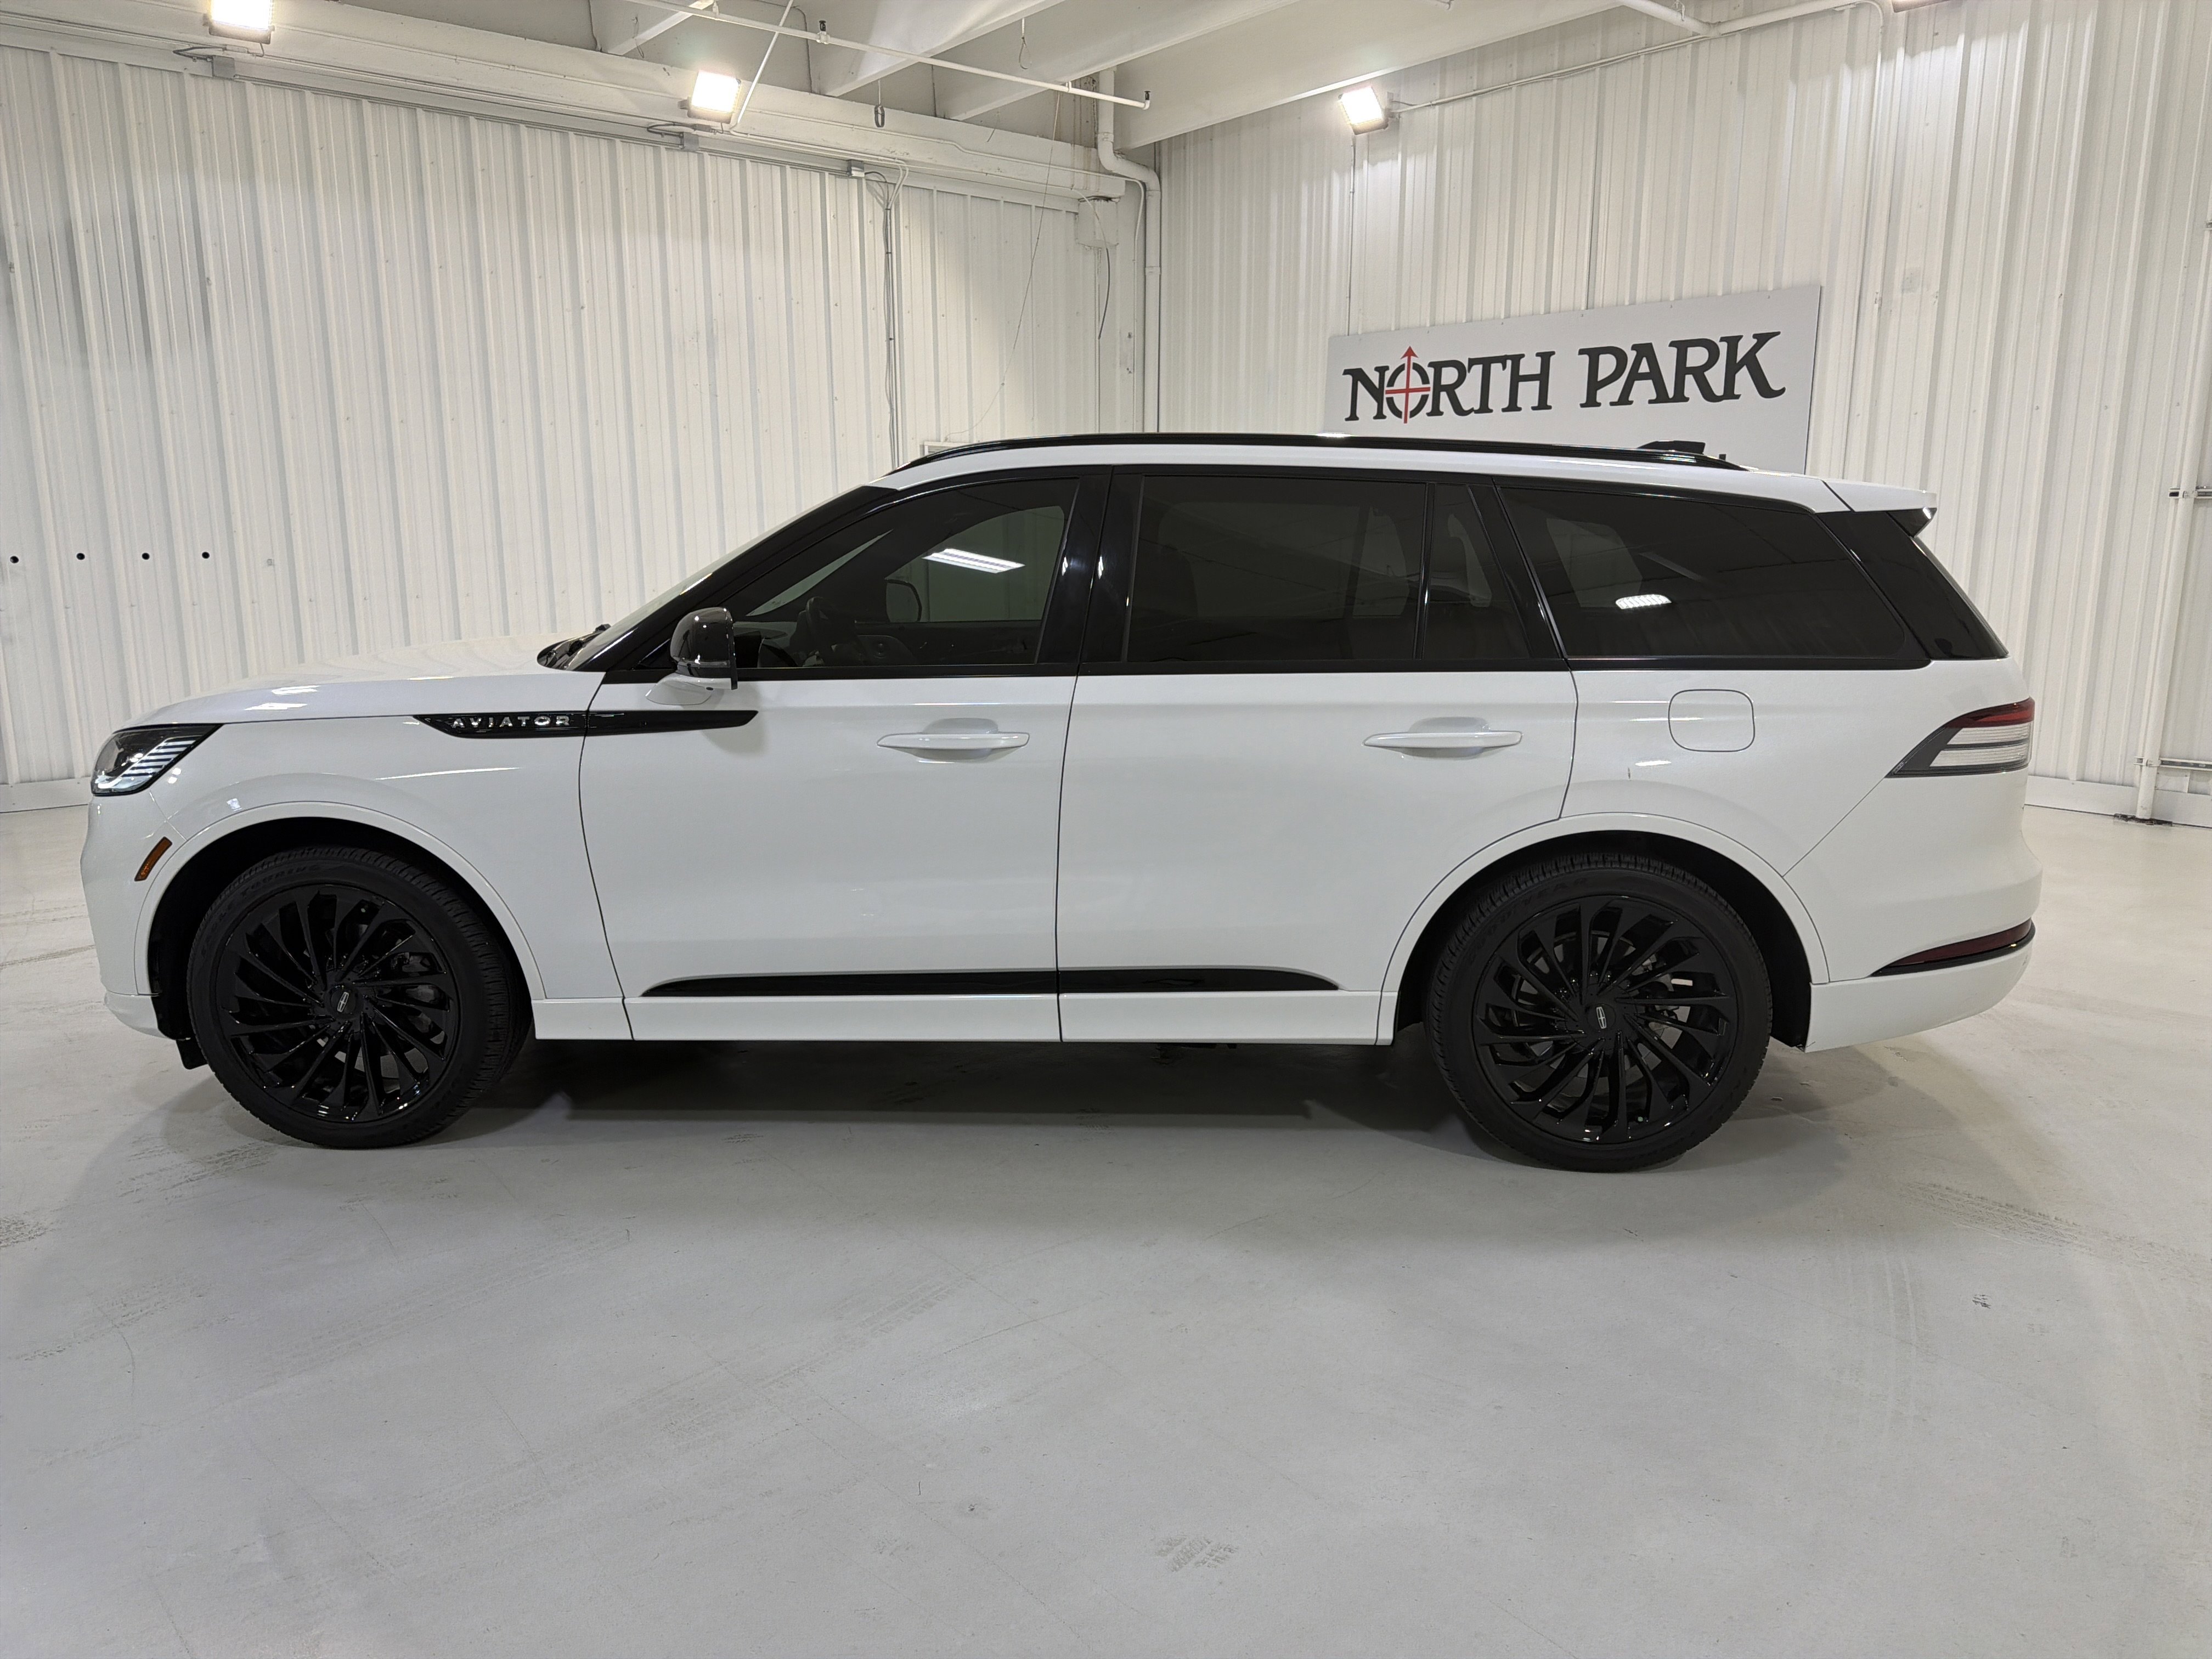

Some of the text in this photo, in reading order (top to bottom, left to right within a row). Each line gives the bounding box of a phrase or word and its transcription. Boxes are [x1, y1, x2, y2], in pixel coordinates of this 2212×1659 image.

[1342, 331, 1786, 421] NORTH PARK
[452, 715, 570, 728] AVIATOR
